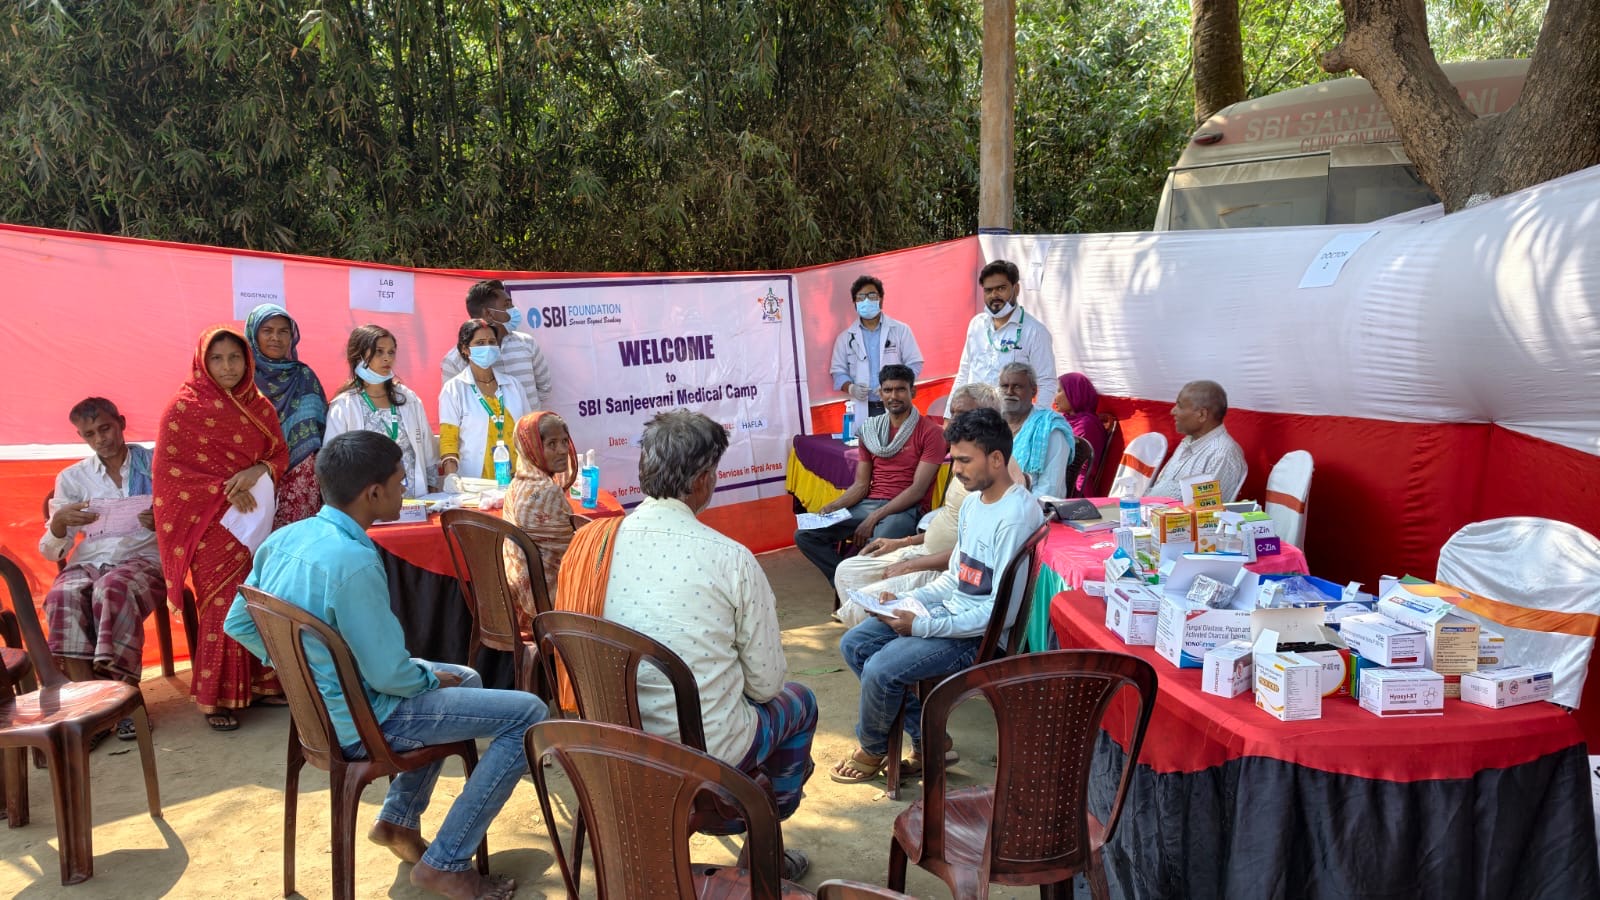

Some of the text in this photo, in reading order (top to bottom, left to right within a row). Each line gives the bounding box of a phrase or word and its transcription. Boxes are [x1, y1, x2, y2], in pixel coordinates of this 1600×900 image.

[1245, 115, 1291, 142] SBI
[1300, 134, 1344, 152] CLINIC
[1349, 131, 1369, 145] ON
[379, 278, 394, 287] LAB
[240, 291, 278, 299] REGISTRATION
[378, 290, 395, 299] TEST
[542, 304, 622, 328] SBI FOUNDATION
[618, 334, 715, 367] WELCOME
[666, 372, 677, 383] to
[578, 384, 758, 417] SBI Sanjeevani Medical Camp
[608, 437, 628, 447] Date:
[618, 487, 628, 496] for
[717, 469, 744, 479] Services
[744, 466, 750, 474] in
[751, 463, 764, 473] Rural
[766, 462, 783, 471] Areas
[1256, 543, 1277, 552] C-Zin
